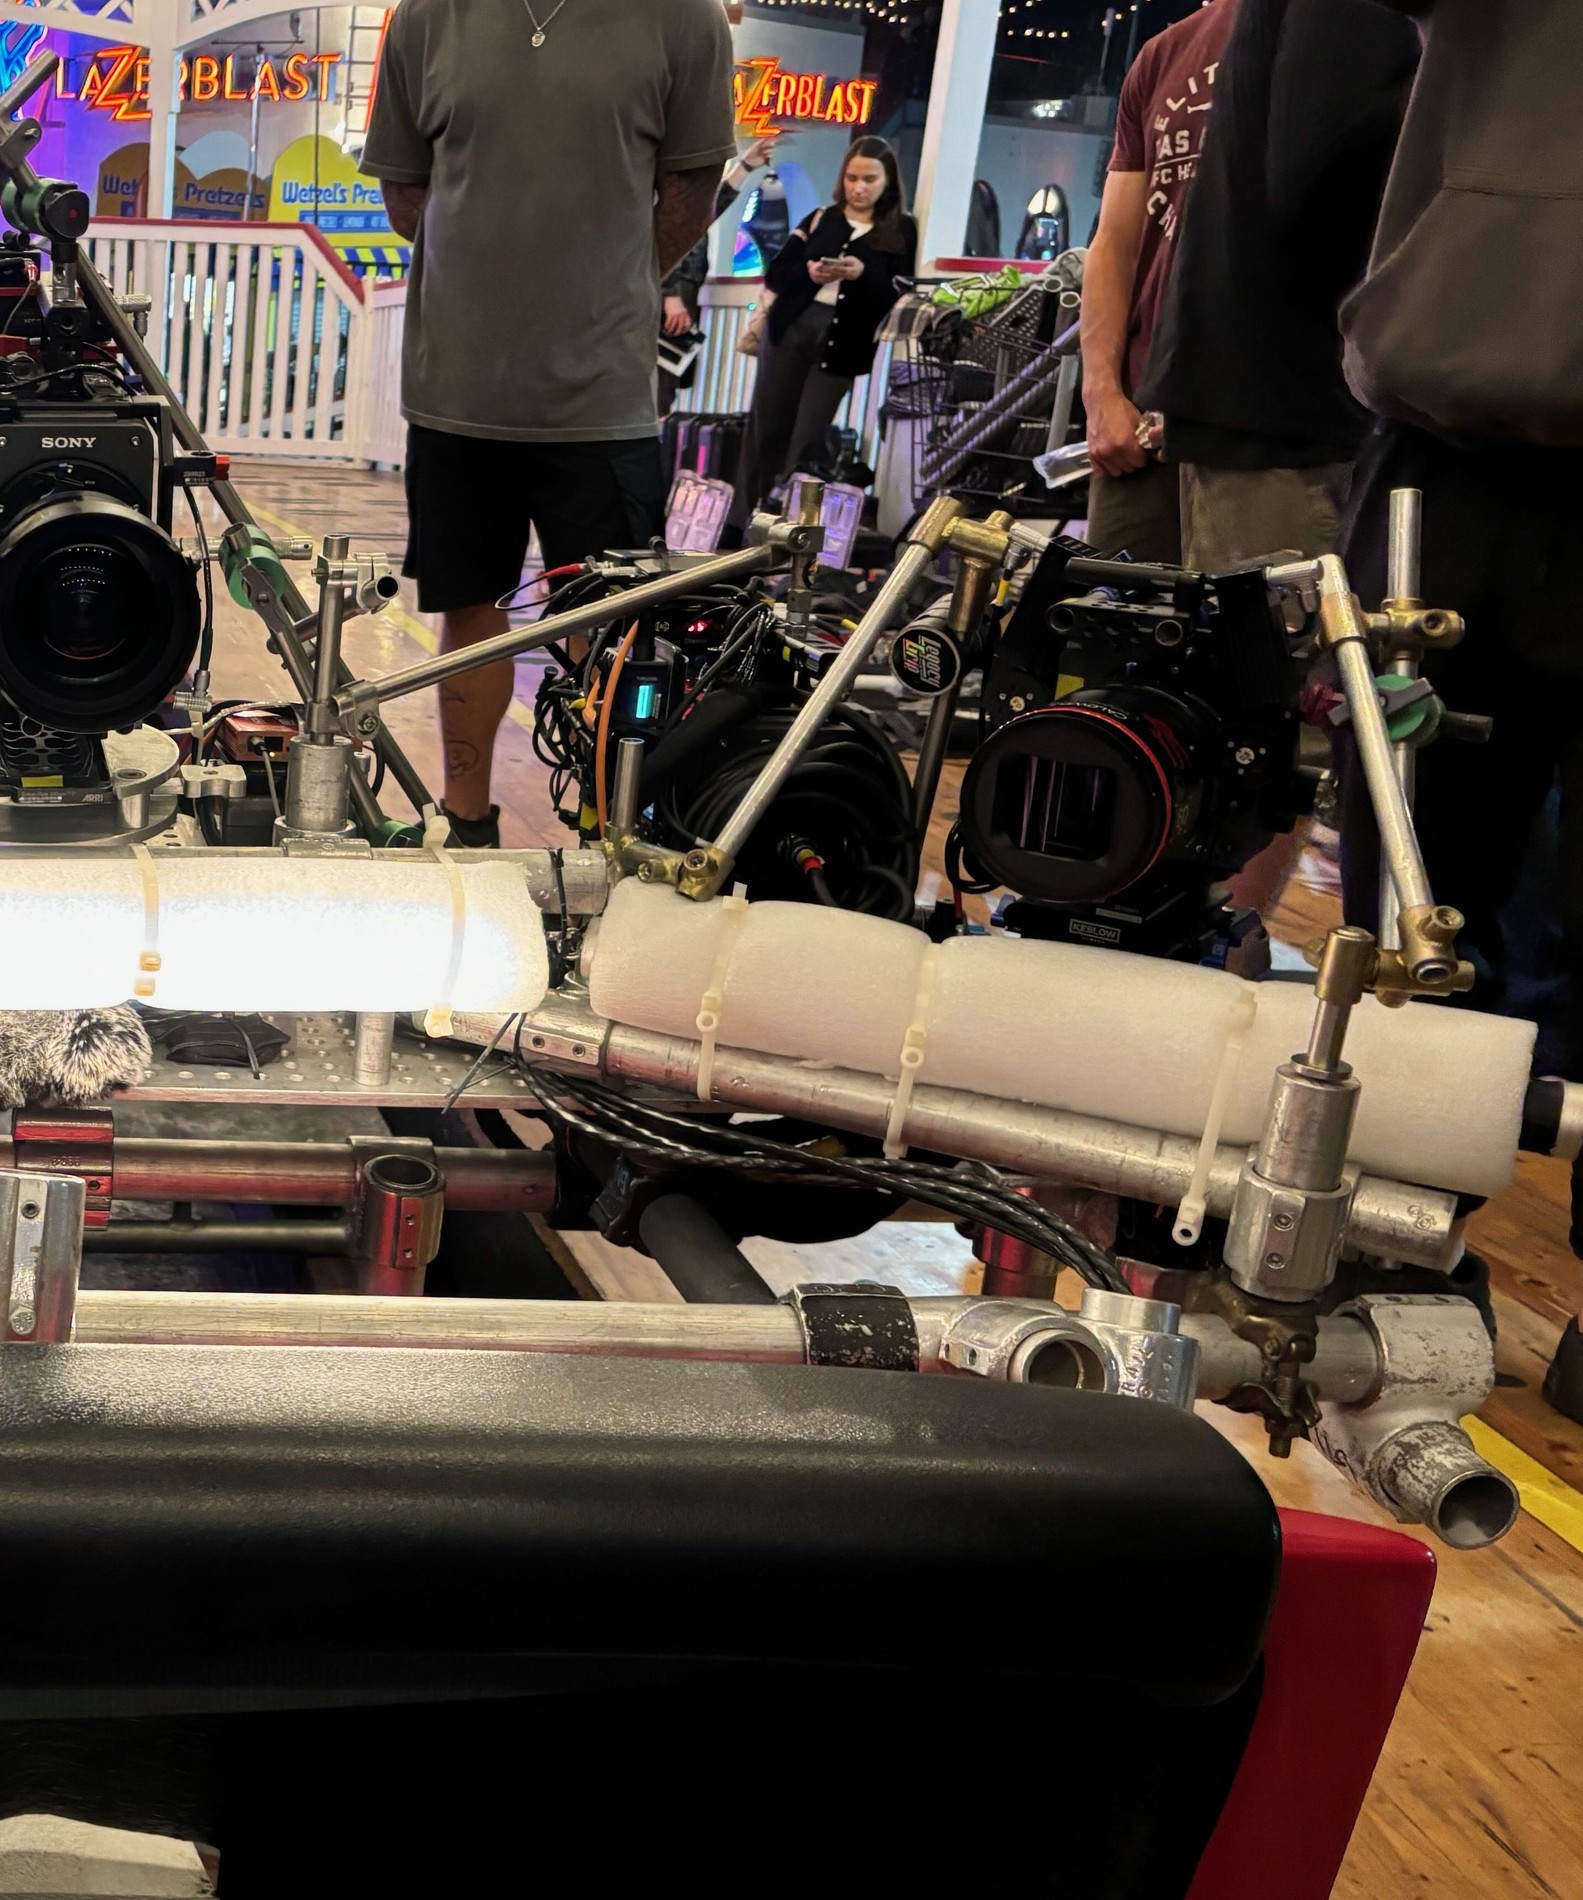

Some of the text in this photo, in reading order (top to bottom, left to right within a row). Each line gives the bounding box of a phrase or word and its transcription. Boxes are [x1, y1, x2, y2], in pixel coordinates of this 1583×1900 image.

[733, 56, 878, 136] AZERBLAST
[184, 181, 266, 209] Pretzes
[282, 181, 384, 205] Wetzel's Pre
[41, 437, 97, 449] SONY
[81, 793, 104, 803] ARRI
[1072, 922, 1117, 939] KESLOW
